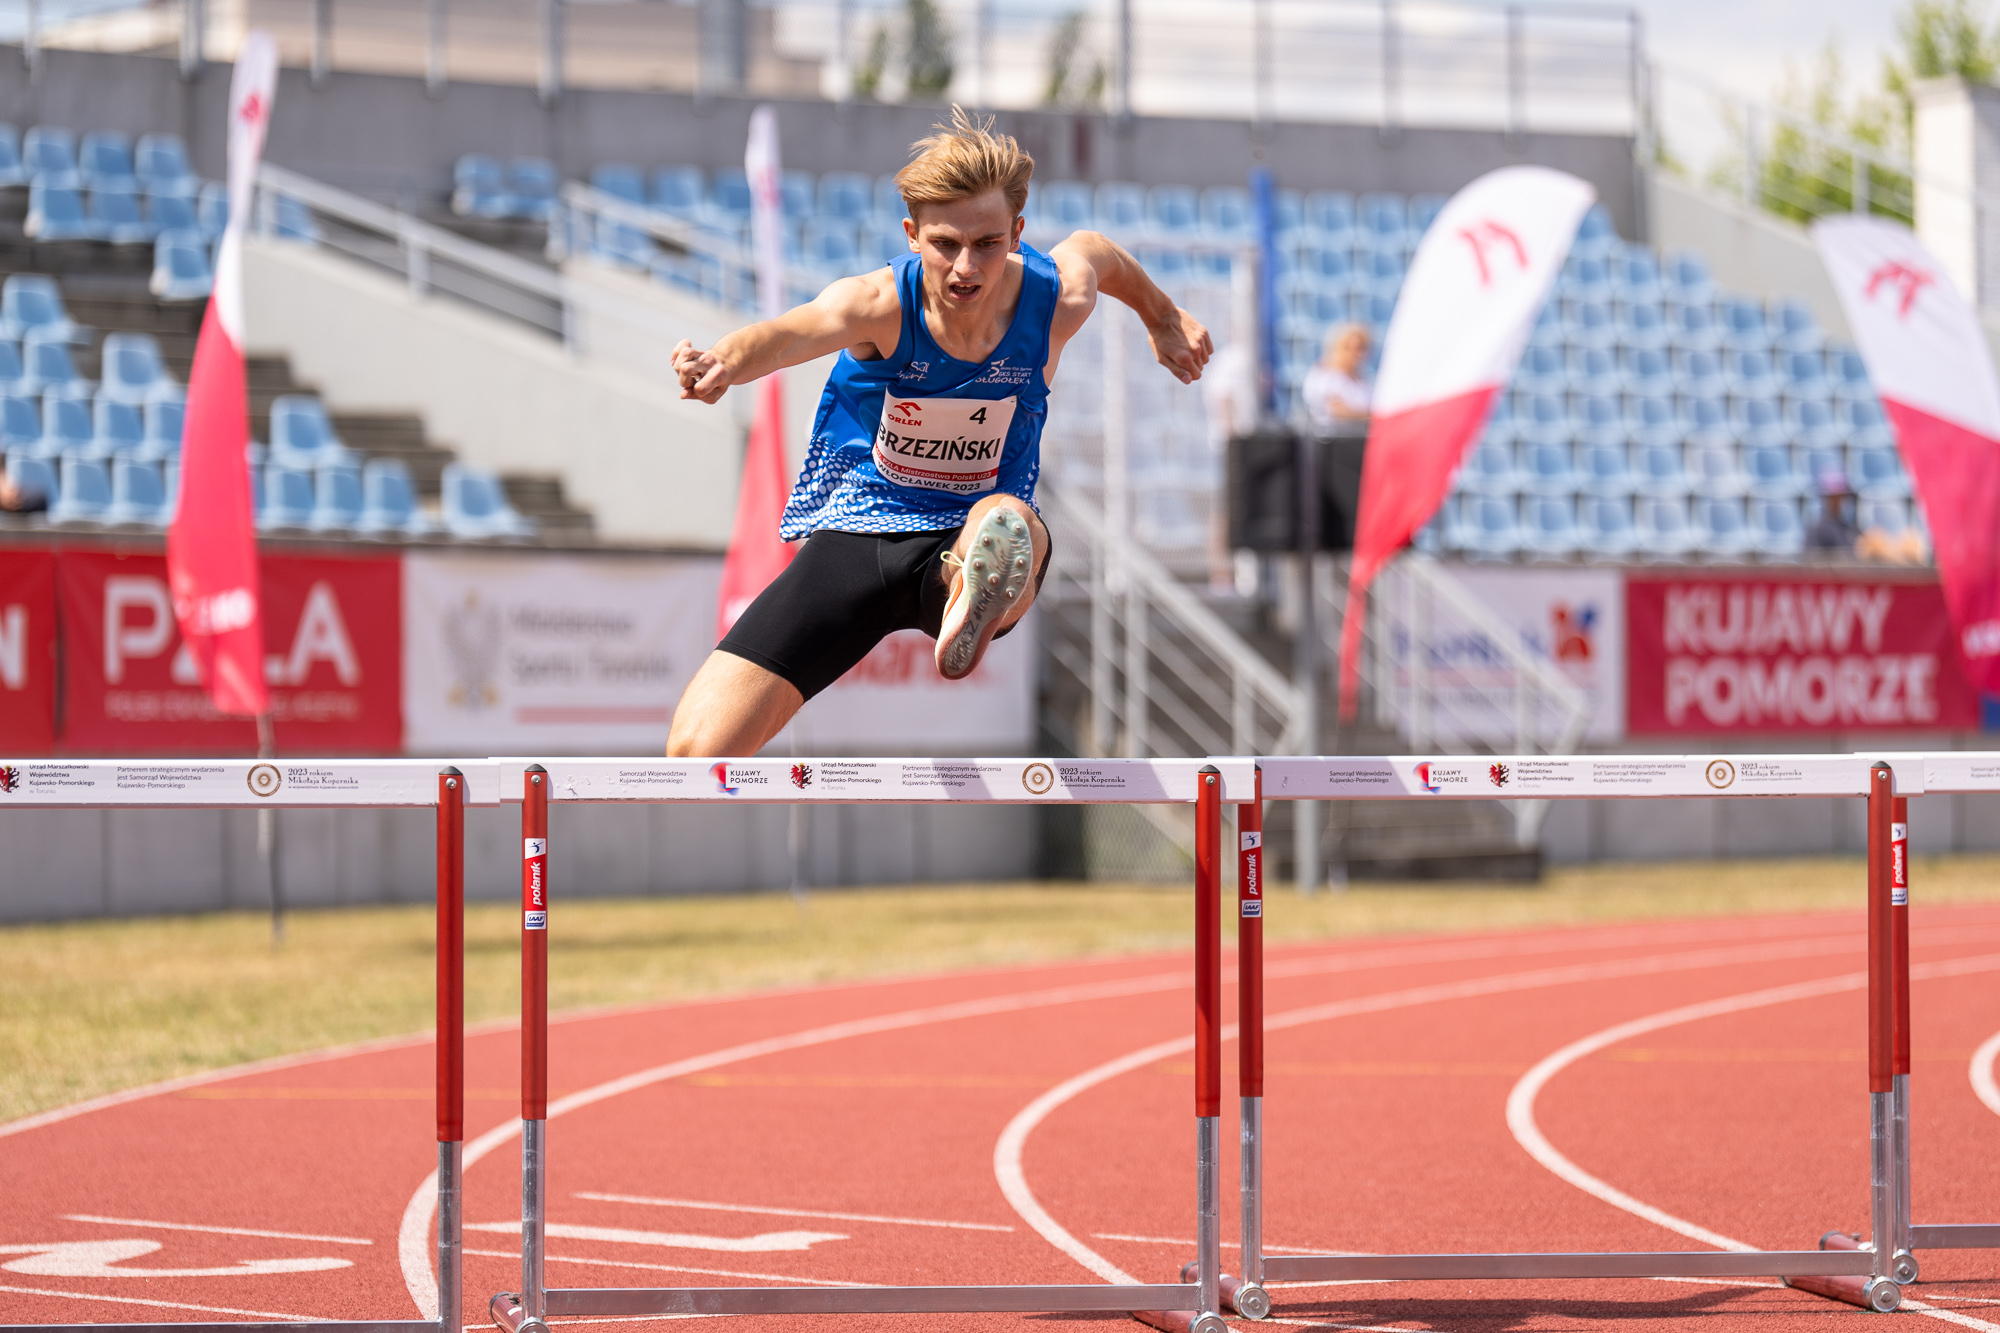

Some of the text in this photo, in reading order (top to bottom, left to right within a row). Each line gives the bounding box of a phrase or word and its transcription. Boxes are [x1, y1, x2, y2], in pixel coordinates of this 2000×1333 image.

[887, 413, 923, 427] ORLEN
[969, 407, 987, 425] 4
[878, 421, 1001, 461] BRZEZIŃSKI
[878, 461, 981, 491] WŁOCŁAWEK 2023
[882, 458, 900, 471] PZLA
[901, 467, 950, 480] Mistrzostwa
[977, 471, 992, 480] U23
[1665, 585, 1892, 652] KUJAWY
[103, 574, 361, 686] PA
[1665, 655, 1939, 727] POMORZE
[149, 766, 190, 774] strategicznym
[191, 766, 225, 774] wydarzenia
[288, 768, 308, 776] 2023
[288, 776, 359, 785] Mikołaja Kopernika
[1060, 767, 1102, 776] 2023 rokiem
[1060, 776, 1125, 784] Mikołaja Kopernika
[1769, 769, 1802, 777] Kopernika
[1246, 854, 1258, 895] polanik
[1893, 844, 1905, 884] polanik
[530, 862, 543, 906] polanik
